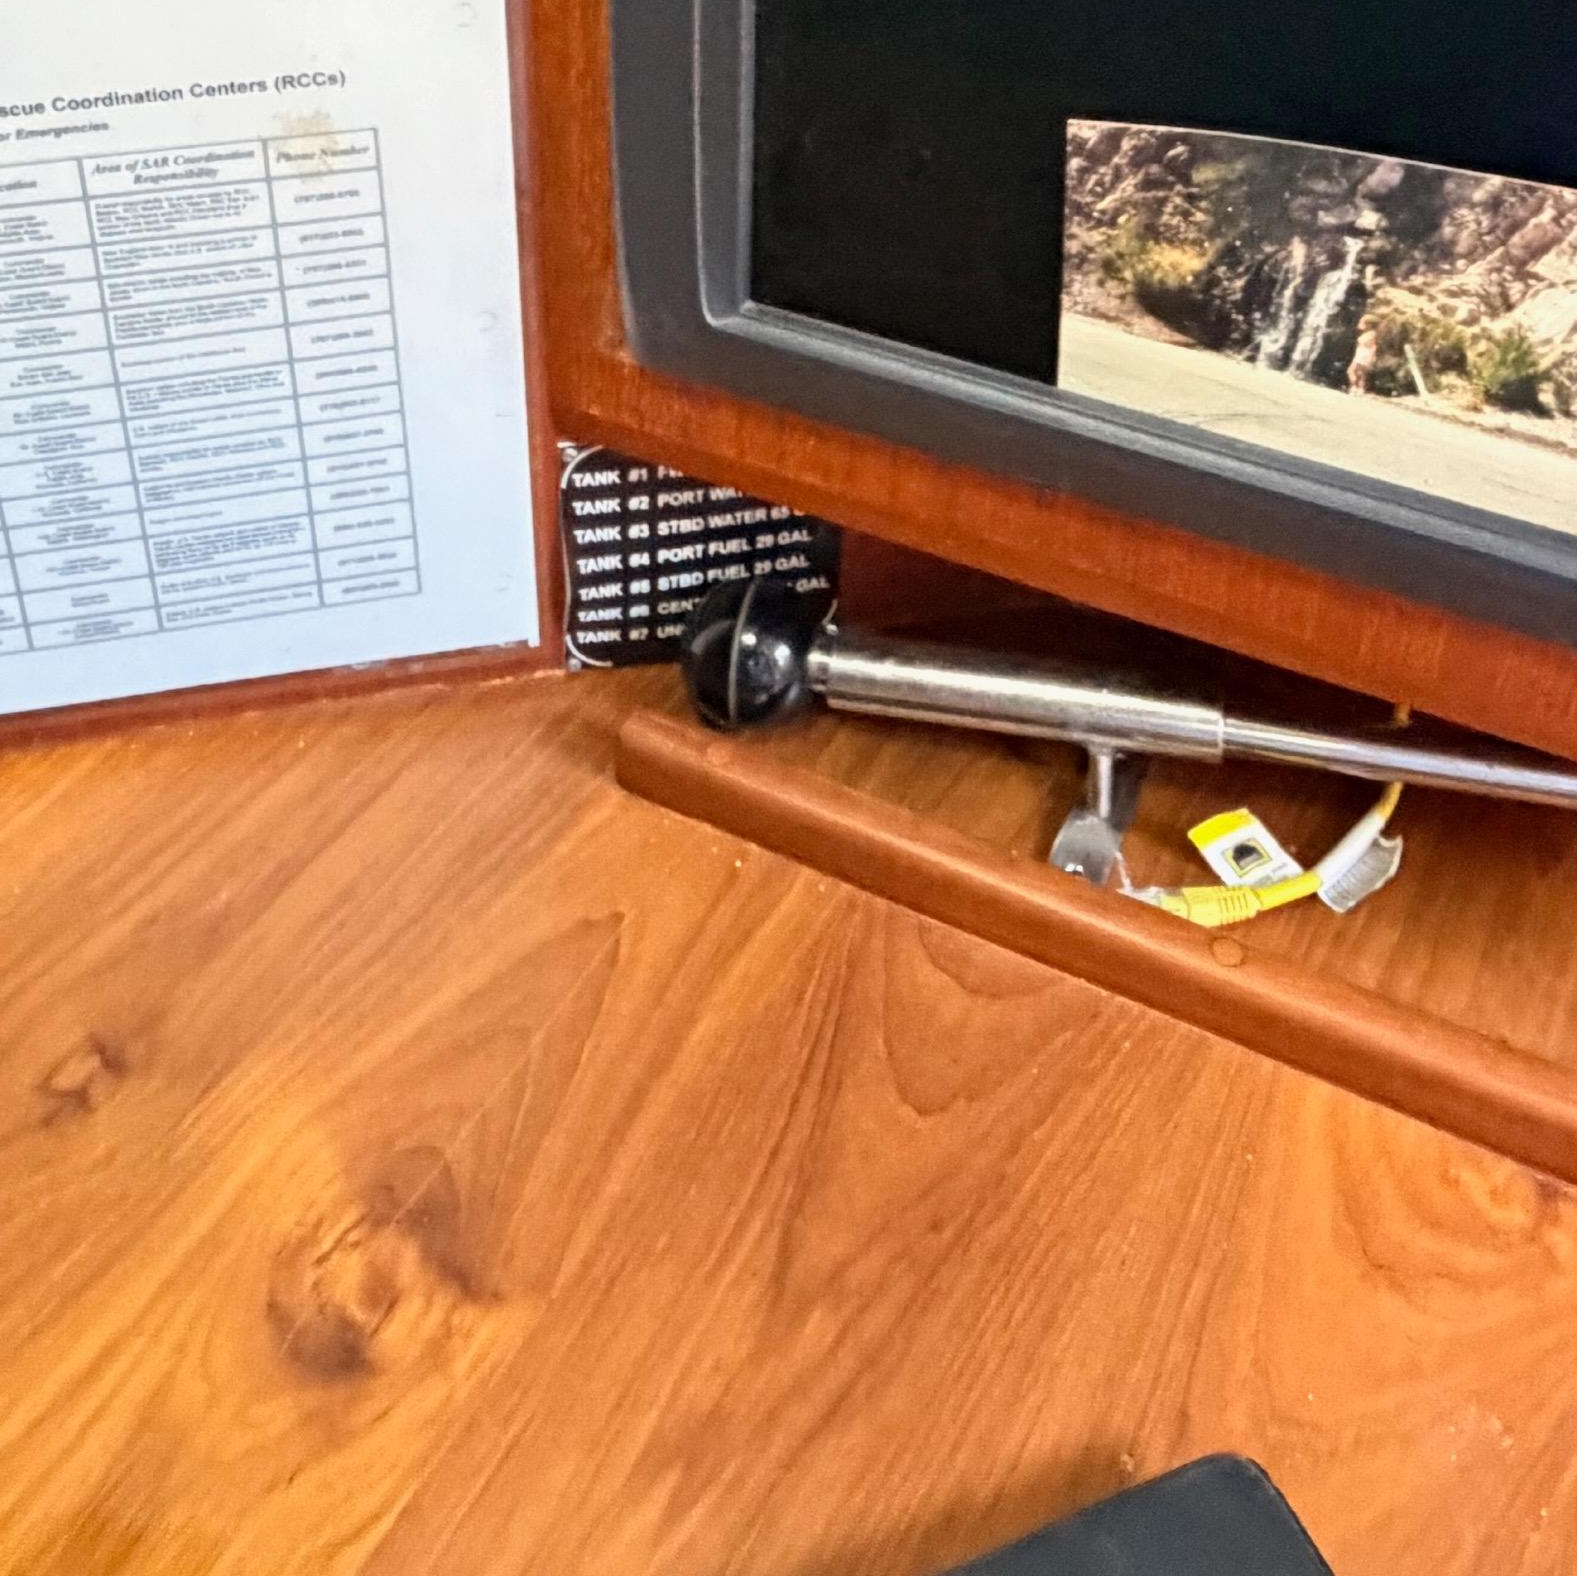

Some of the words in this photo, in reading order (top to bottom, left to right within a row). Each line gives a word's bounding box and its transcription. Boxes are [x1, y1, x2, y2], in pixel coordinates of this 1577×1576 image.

[52, 86, 184, 114] Coordination
[189, 79, 268, 99] Centers
[274, 69, 347, 93] (RCCs)
[15, 120, 110, 142] Emergencies
[92, 161, 123, 176] Area
[174, 148, 255, 167] Coordination
[319, 144, 371, 161] Number
[133, 166, 219, 187] Responsibility
[572, 471, 621, 487] TANK
[628, 468, 648, 483] #1
[572, 499, 621, 516] TANK
[628, 496, 650, 511] #2
[657, 489, 704, 508] PORT
[573, 527, 621, 544] TANK
[628, 524, 650, 539] #3
[657, 517, 705, 536] STBD
[708, 507, 767, 528] WATER
[577, 556, 623, 574] TANK
[629, 553, 651, 568] #4
[657, 544, 705, 564] PORT
[708, 538, 752, 557] FUEL
[777, 529, 812, 546] GAL
[579, 583, 623, 601] TANK
[657, 572, 705, 592] STBD
[707, 565, 751, 584] FUEL
[774, 555, 810, 572] GAL
[795, 576, 830, 593] GAL
[578, 607, 623, 622] TANK
[576, 629, 622, 644] TANK
[628, 627, 649, 641] #7
